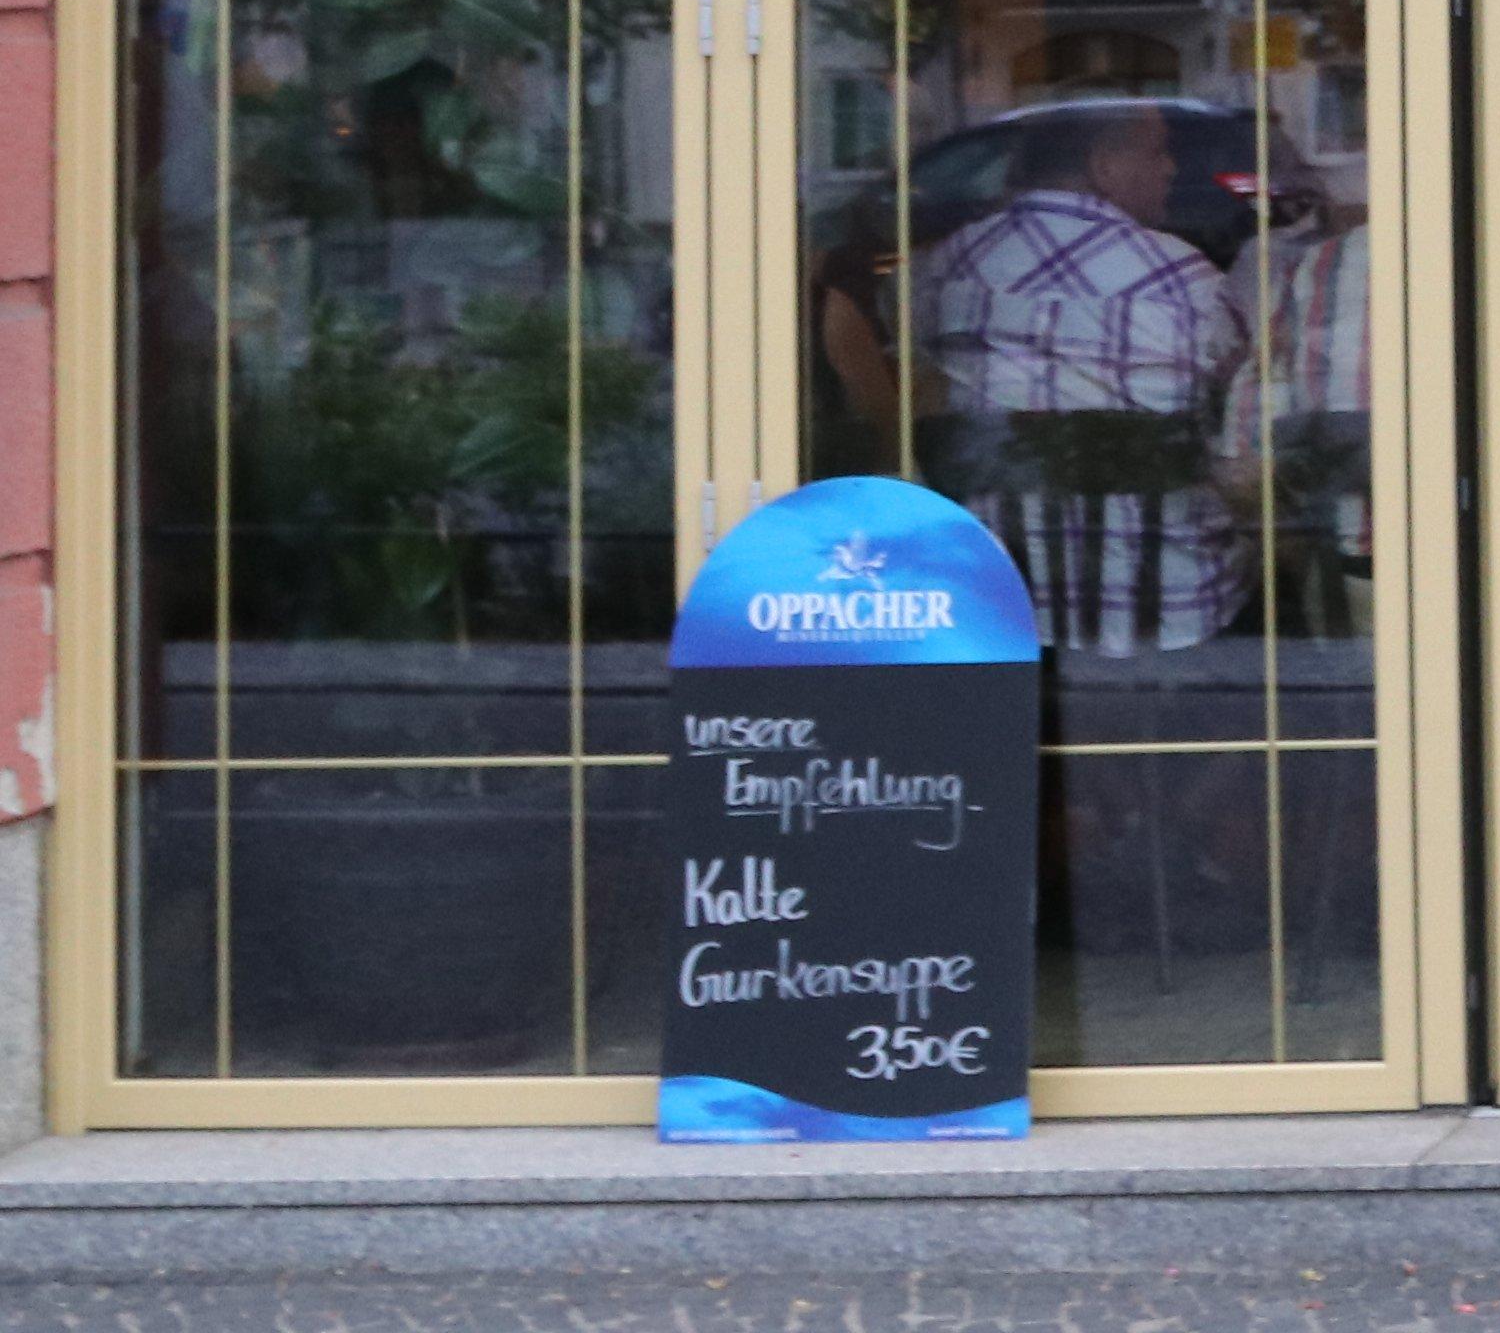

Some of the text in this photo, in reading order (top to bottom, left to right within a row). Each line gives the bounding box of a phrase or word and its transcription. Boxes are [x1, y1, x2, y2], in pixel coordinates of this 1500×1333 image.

[747, 589, 955, 632] OPPACHER
[724, 756, 965, 851] Empfehlung
[683, 855, 809, 928] Kalte
[679, 938, 976, 1023] Gurkensuppe
